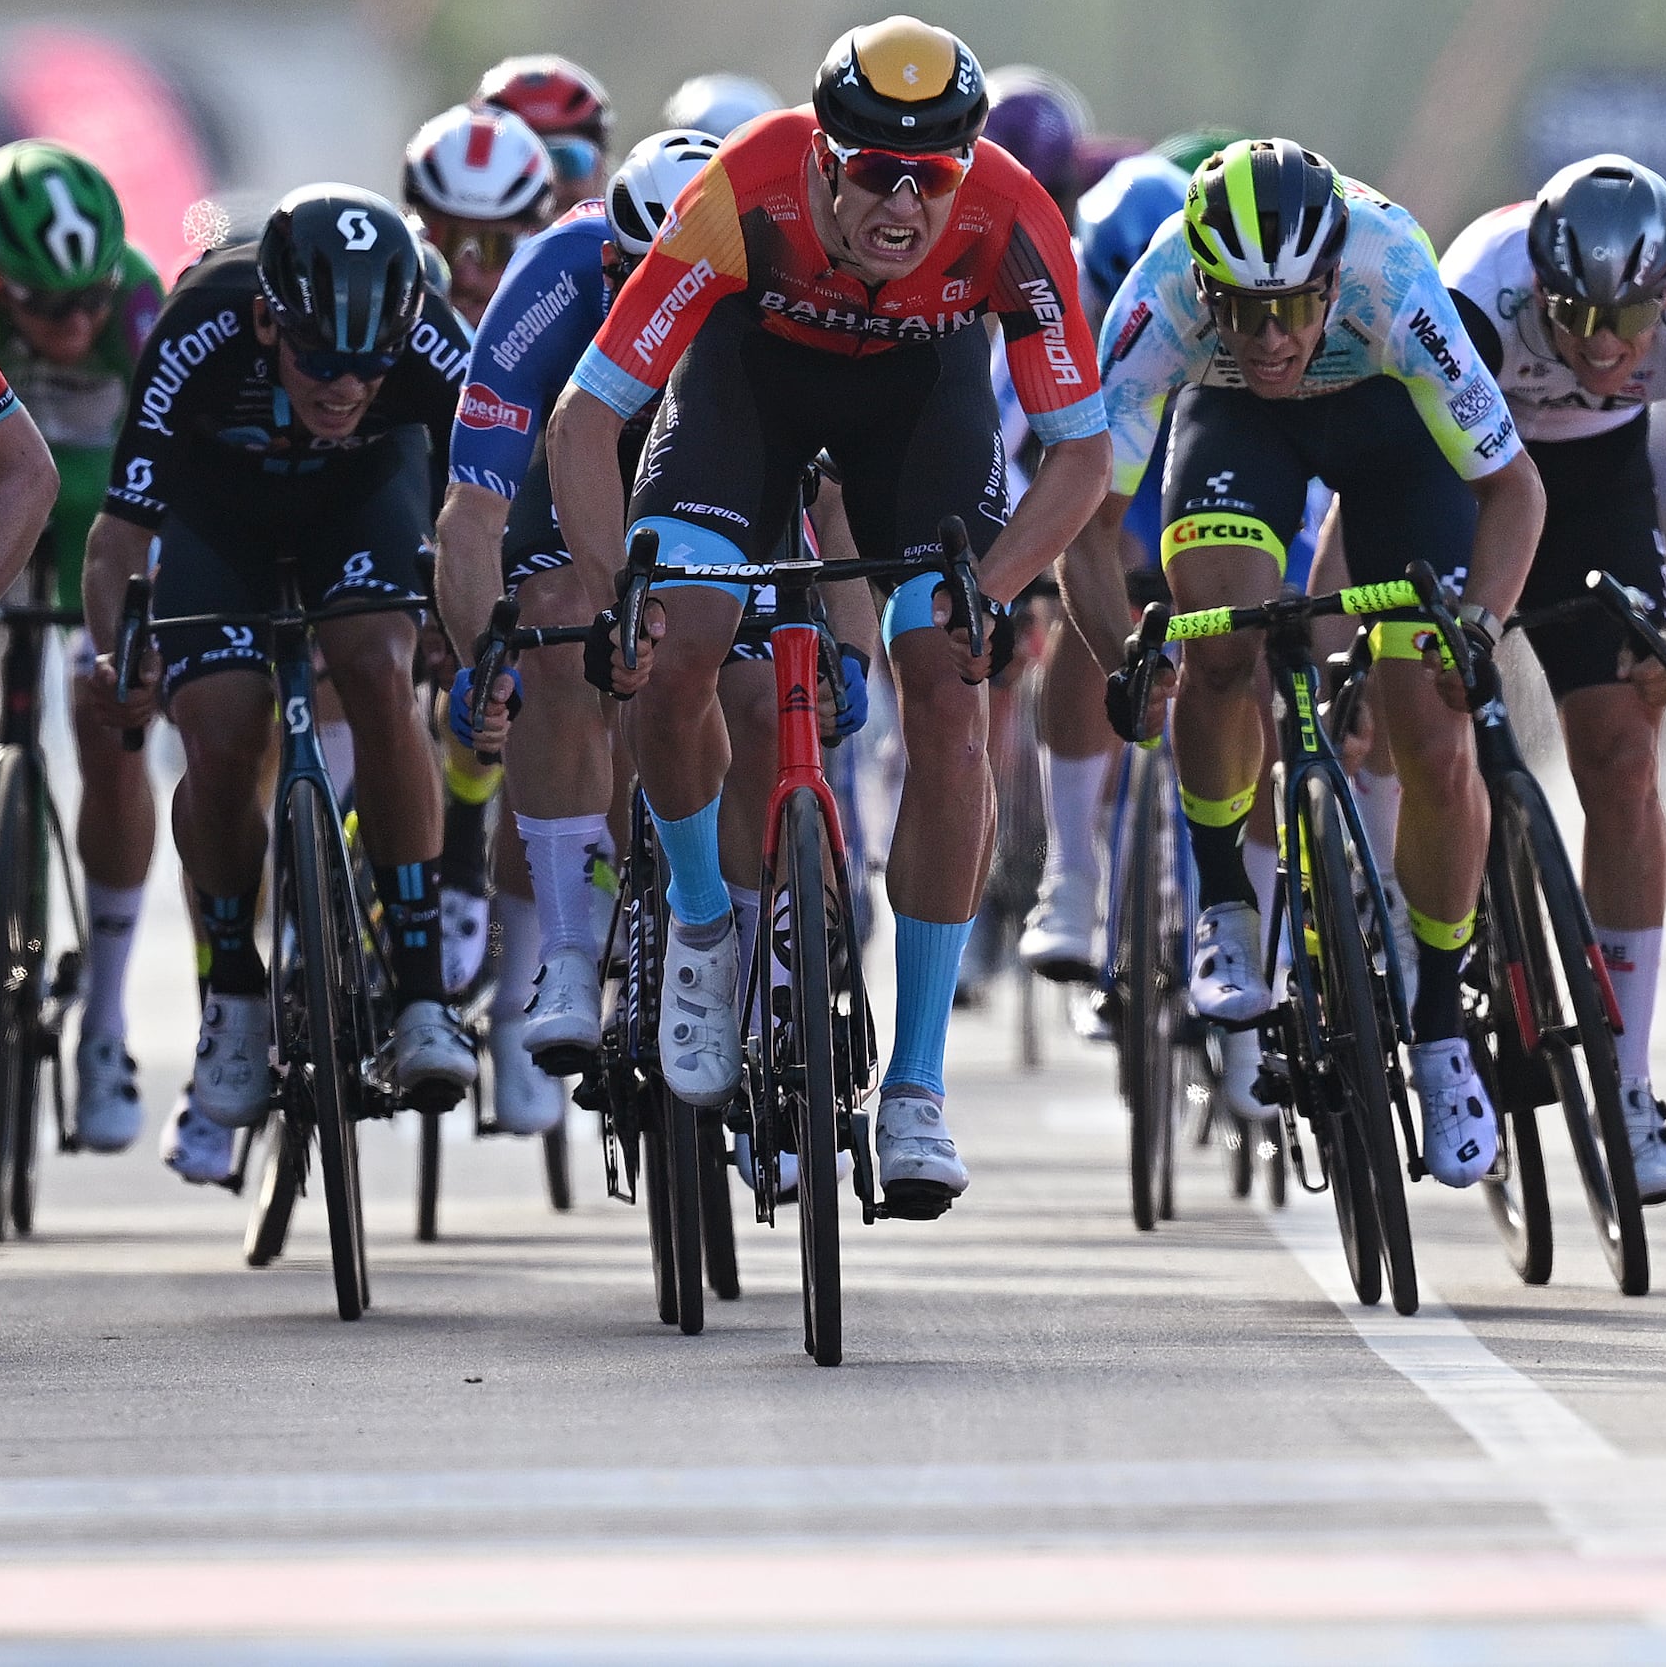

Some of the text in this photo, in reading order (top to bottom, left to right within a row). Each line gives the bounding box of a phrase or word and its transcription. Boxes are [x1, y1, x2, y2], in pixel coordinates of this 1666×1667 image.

[632, 257, 717, 366] MERIDA
[758, 290, 976, 334] BAHRAIN
[1254, 278, 1286, 287] uvex
[489, 269, 580, 373] deceuninck
[1017, 277, 1083, 385] MERIDA
[1408, 307, 1462, 382] Wallonie
[137, 309, 242, 437] youfone
[1449, 379, 1486, 413] PIERRE
[461, 390, 519, 424] lpecin
[671, 500, 751, 529] MERIDA
[1172, 520, 1264, 545] Circus
[1291, 671, 1319, 753] CUBE
